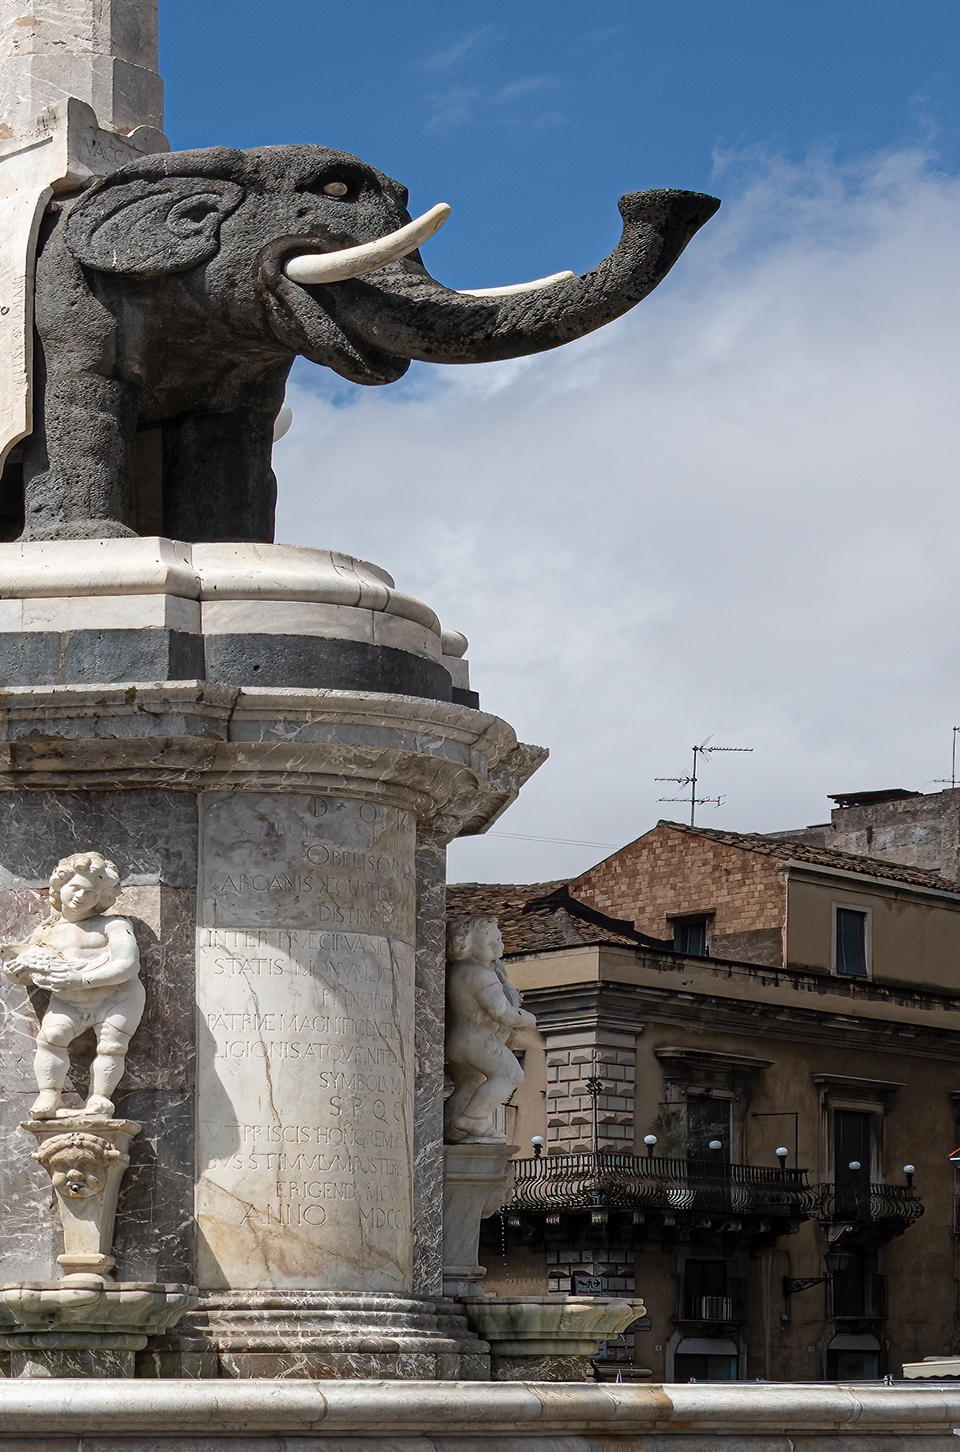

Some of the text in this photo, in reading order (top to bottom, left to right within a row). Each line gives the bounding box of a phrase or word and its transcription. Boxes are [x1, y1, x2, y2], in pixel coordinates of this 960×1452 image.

[208, 930, 268, 948] INTER
[214, 958, 285, 976] STATIS
[239, 1203, 328, 1227] ANNO
